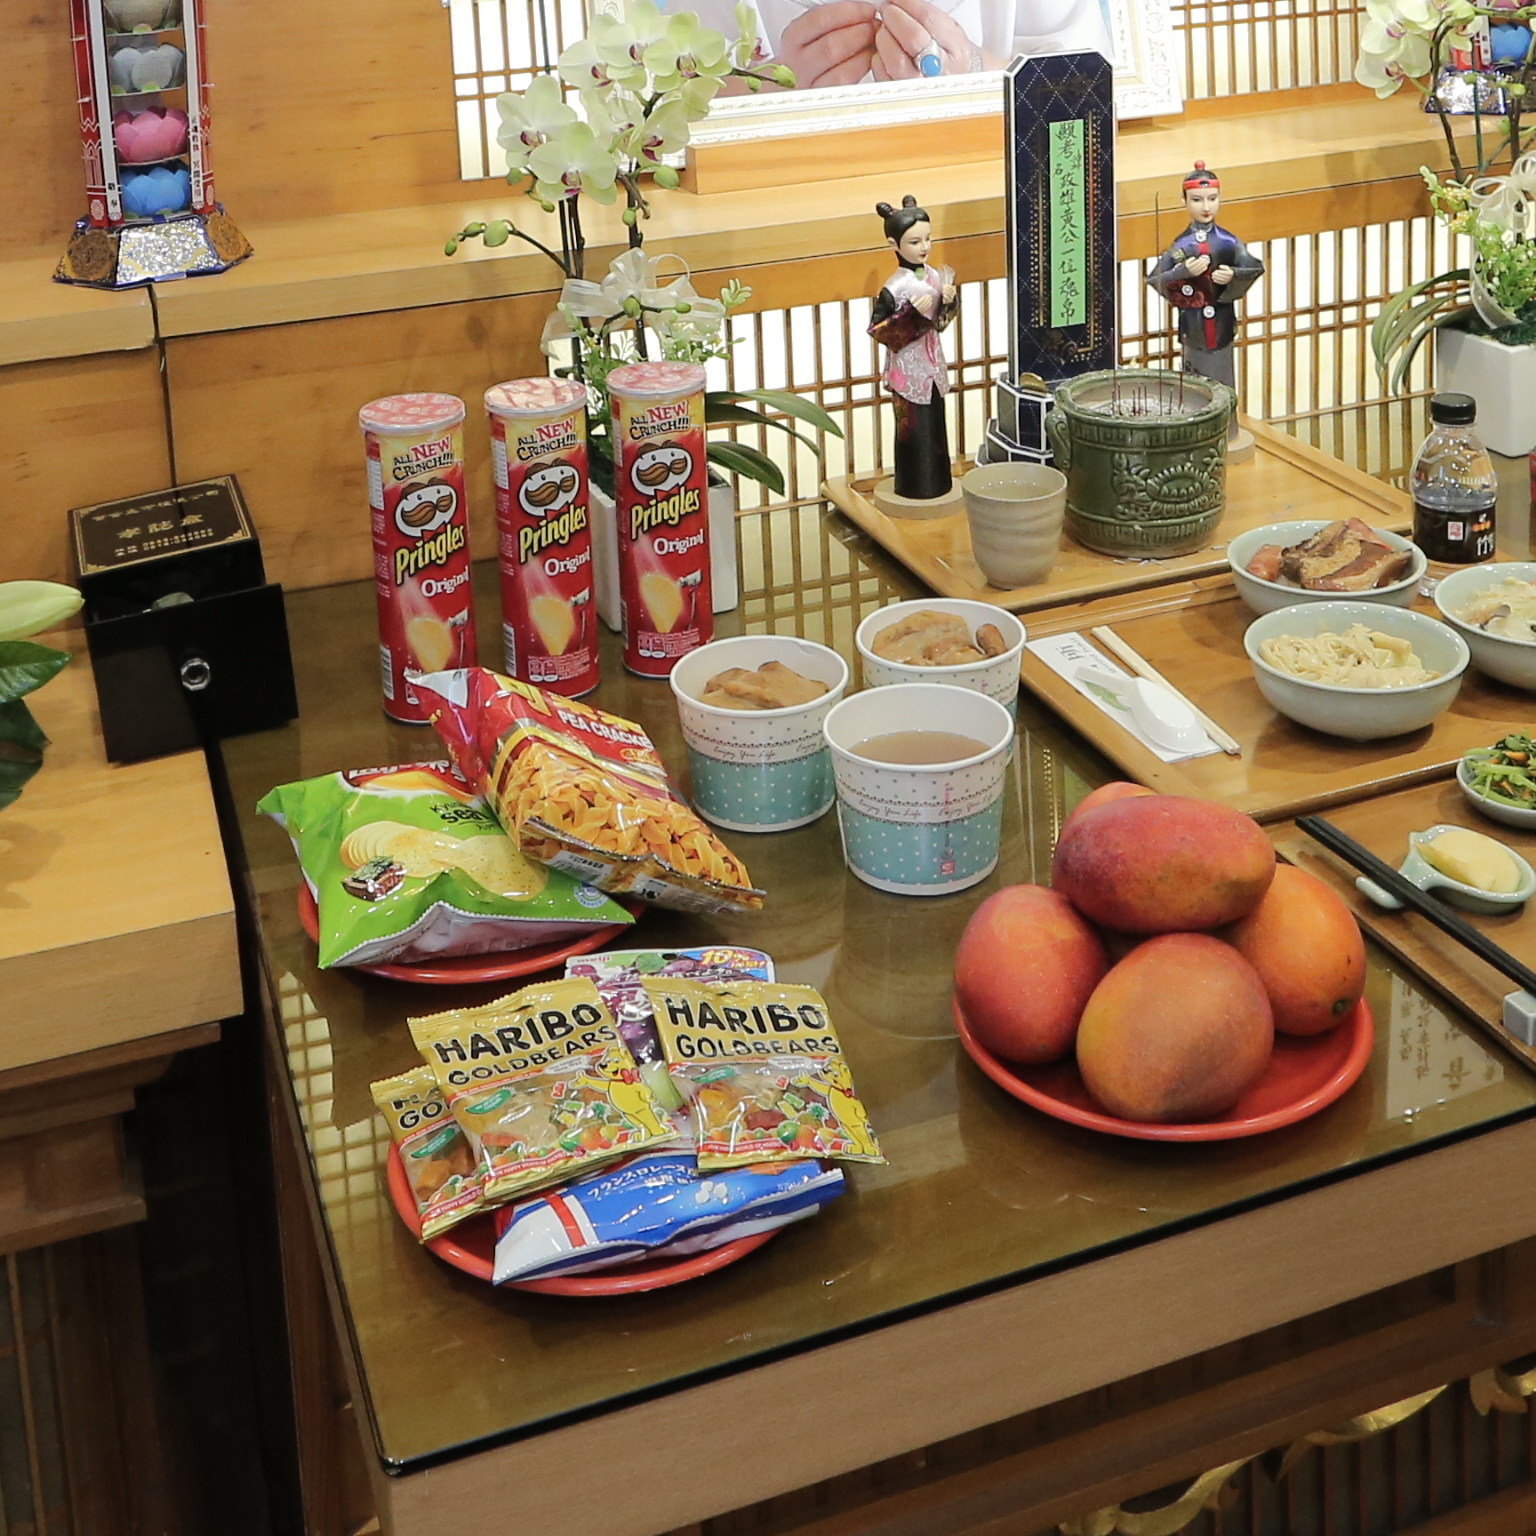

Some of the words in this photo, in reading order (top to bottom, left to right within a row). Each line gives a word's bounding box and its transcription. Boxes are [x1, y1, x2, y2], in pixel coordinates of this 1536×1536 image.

[518, 435, 537, 446] ALL
[536, 418, 574, 442] NEW
[631, 415, 648, 425] ALL
[647, 401, 688, 423] NEW
[394, 452, 413, 465] ALL
[411, 437, 451, 462] NEW
[631, 486, 700, 541] Pringles
[519, 504, 587, 563] Pringles
[395, 524, 465, 585] Pringles
[558, 710, 591, 733] PEA
[433, 1003, 603, 1063] HARIBO
[665, 997, 827, 1035] HARIBO
[448, 1025, 618, 1085] GOLDBEARS
[676, 1033, 840, 1058] GOLDBEARS
